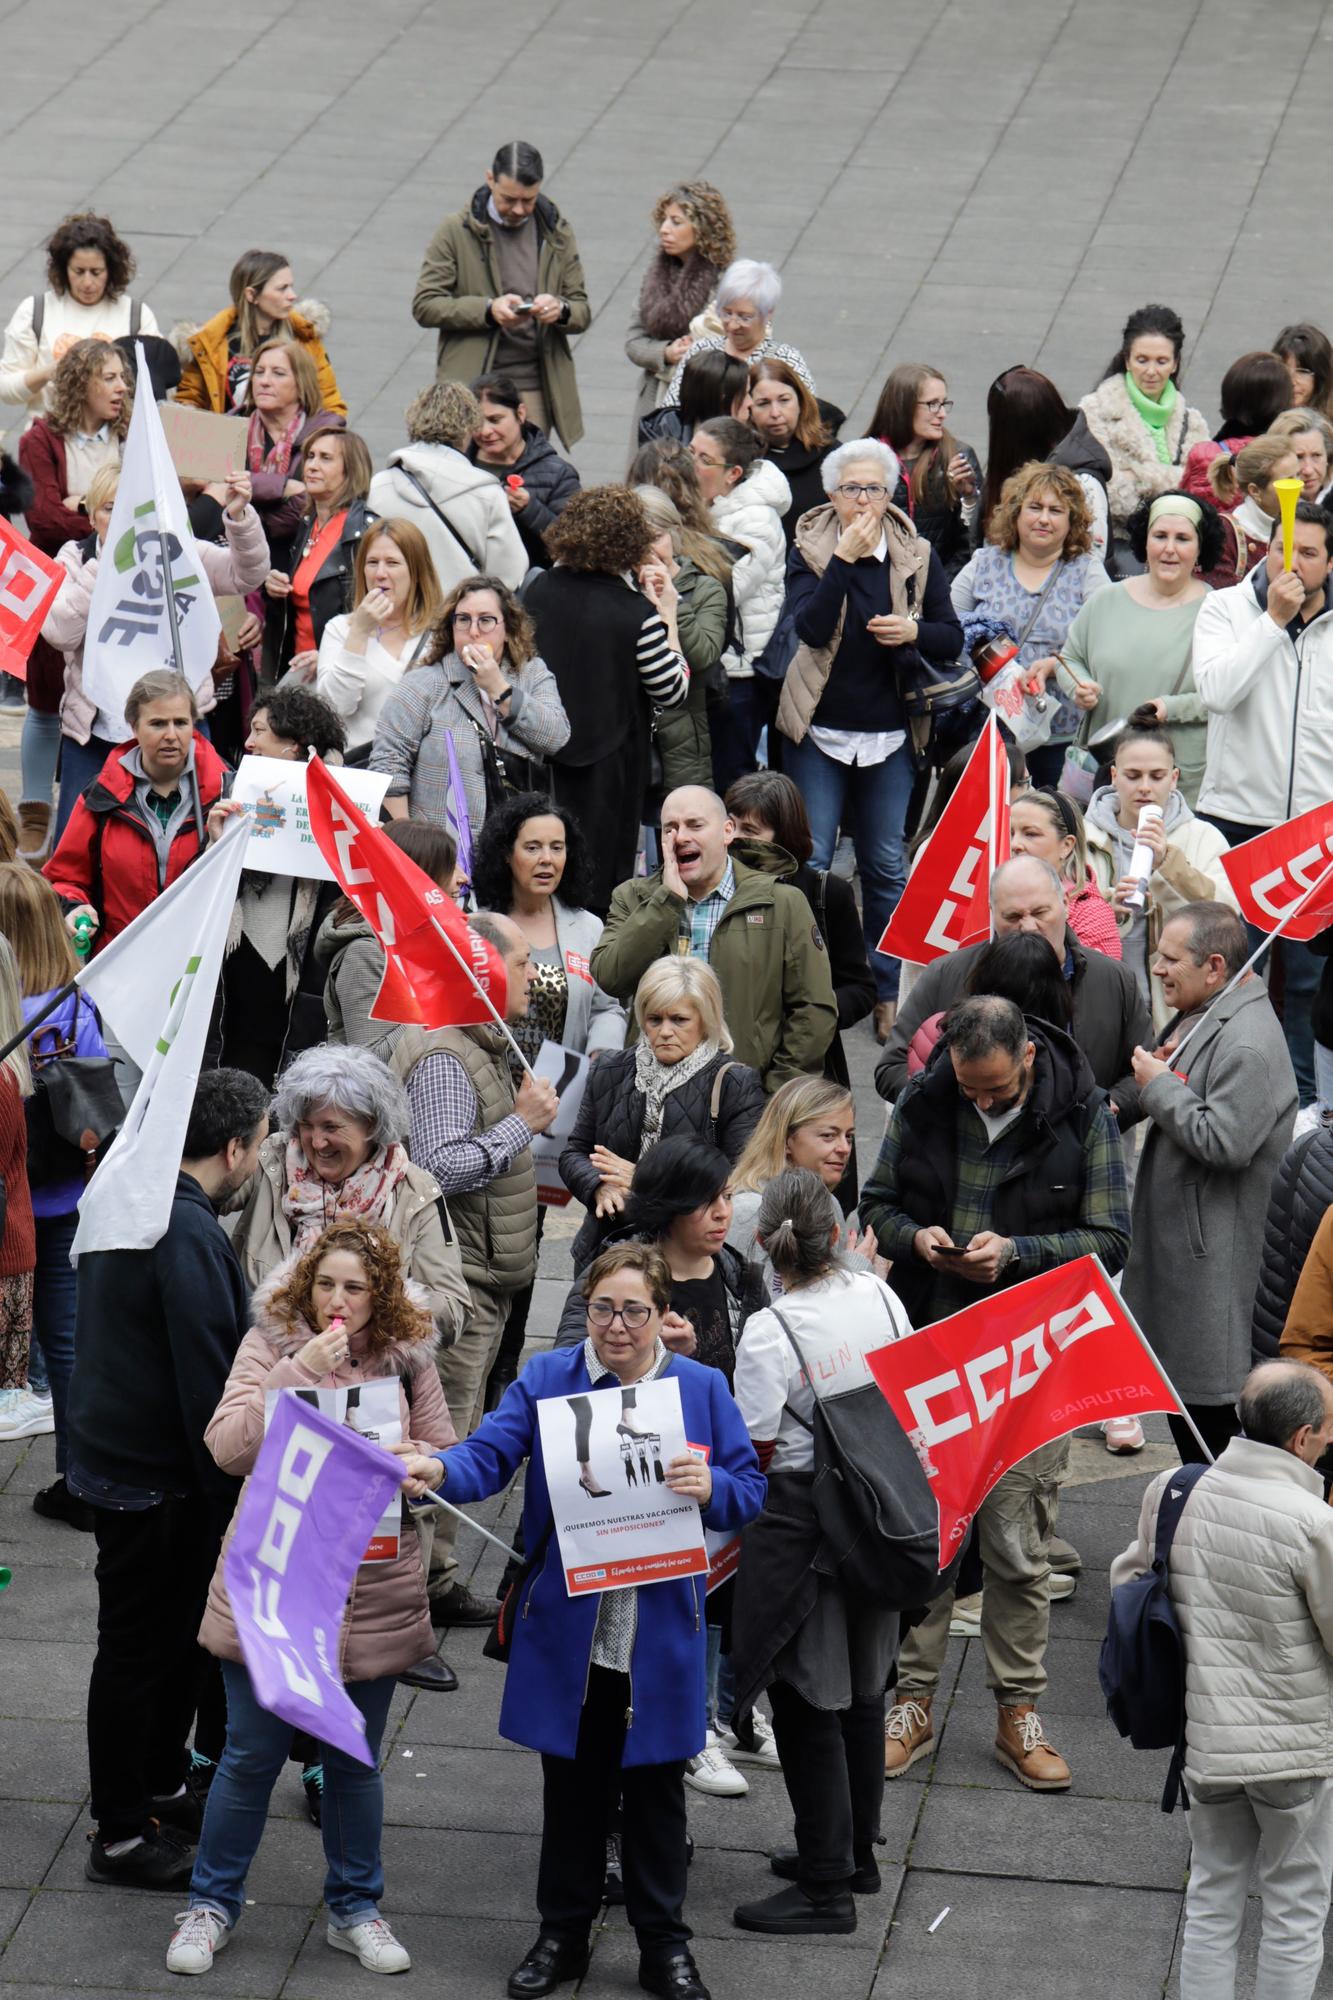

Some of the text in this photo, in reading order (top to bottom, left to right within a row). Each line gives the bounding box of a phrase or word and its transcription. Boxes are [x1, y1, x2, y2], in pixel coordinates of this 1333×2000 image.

[904, 1290, 1115, 1448] CCOO
[564, 1505, 693, 1533] ¡QUEREMOS NUESTRAS VACACIONES
[595, 1519, 665, 1536] SIN IMPOSICIONES!
